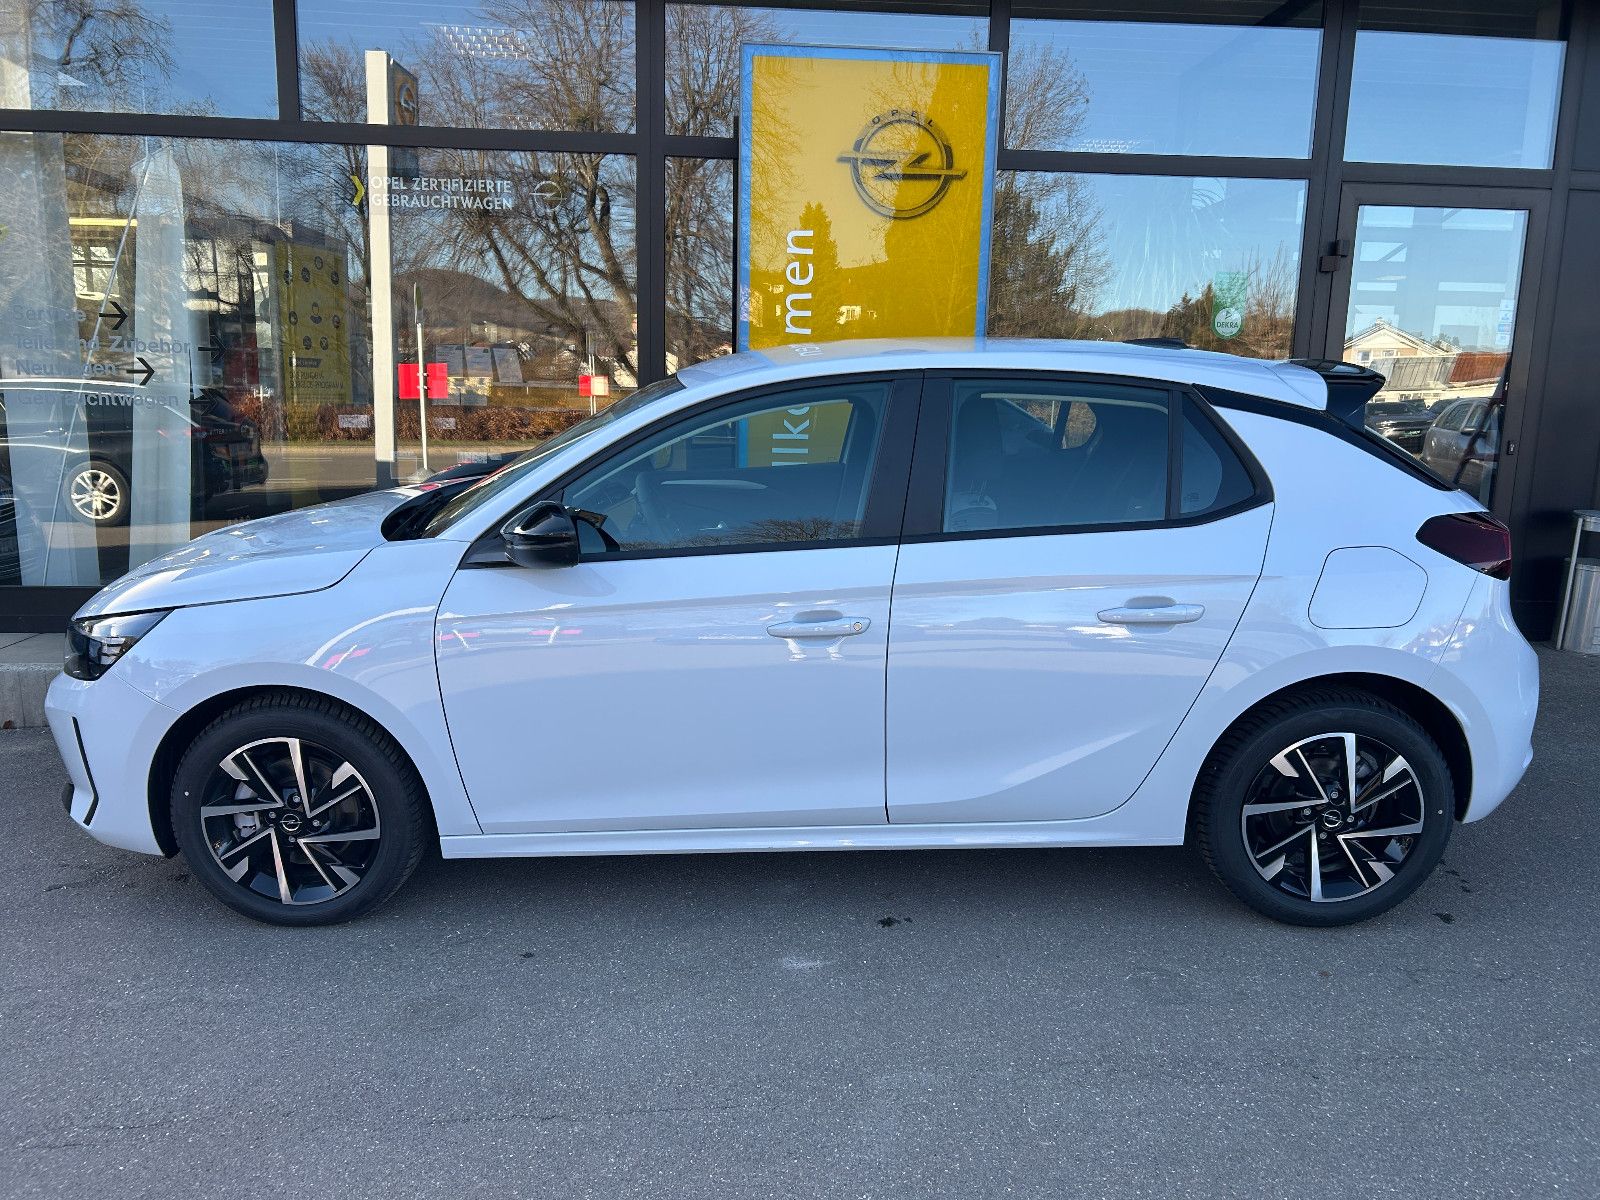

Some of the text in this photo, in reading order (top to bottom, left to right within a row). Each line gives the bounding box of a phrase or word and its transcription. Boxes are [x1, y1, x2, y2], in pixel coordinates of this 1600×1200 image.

[872, 108, 934, 128] OPEL
[370, 175, 512, 194] OPEL ZERTIFIZIERTE
[370, 193, 513, 211] GEBRAUCHTWAGEN
[1216, 321, 1239, 329] DEKRA
[109, 336, 191, 354] Zubehör
[16, 360, 117, 378] Neugen
[18, 390, 178, 409] Gebchtwagen
